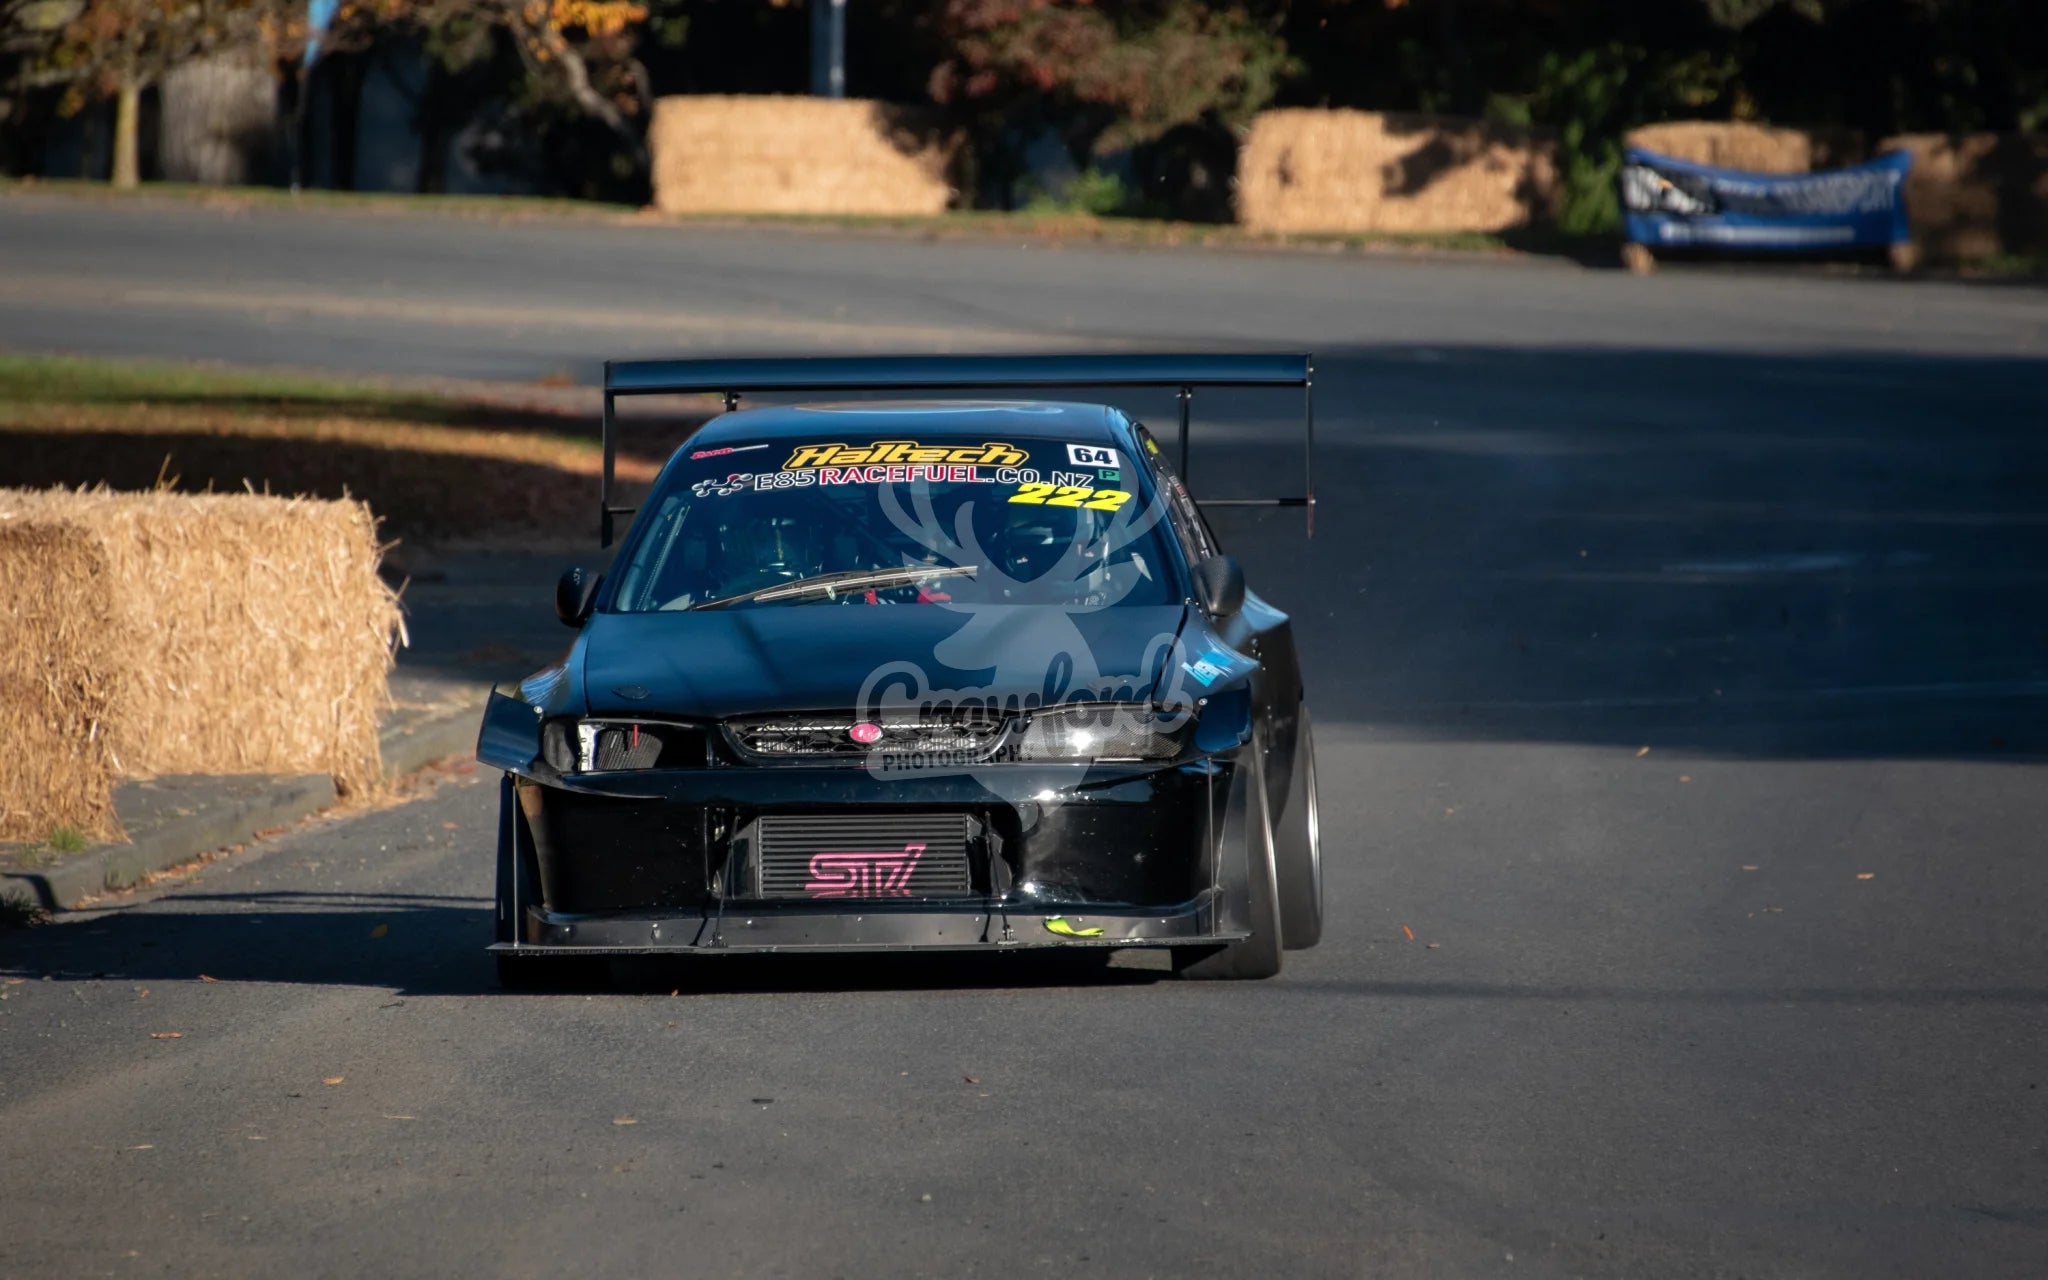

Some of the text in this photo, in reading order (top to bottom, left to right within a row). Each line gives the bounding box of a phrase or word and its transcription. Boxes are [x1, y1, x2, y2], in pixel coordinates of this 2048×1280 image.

[786, 442, 1028, 469] Haltech
[1073, 447, 1113, 465] 64
[1008, 484, 1132, 511] 222
